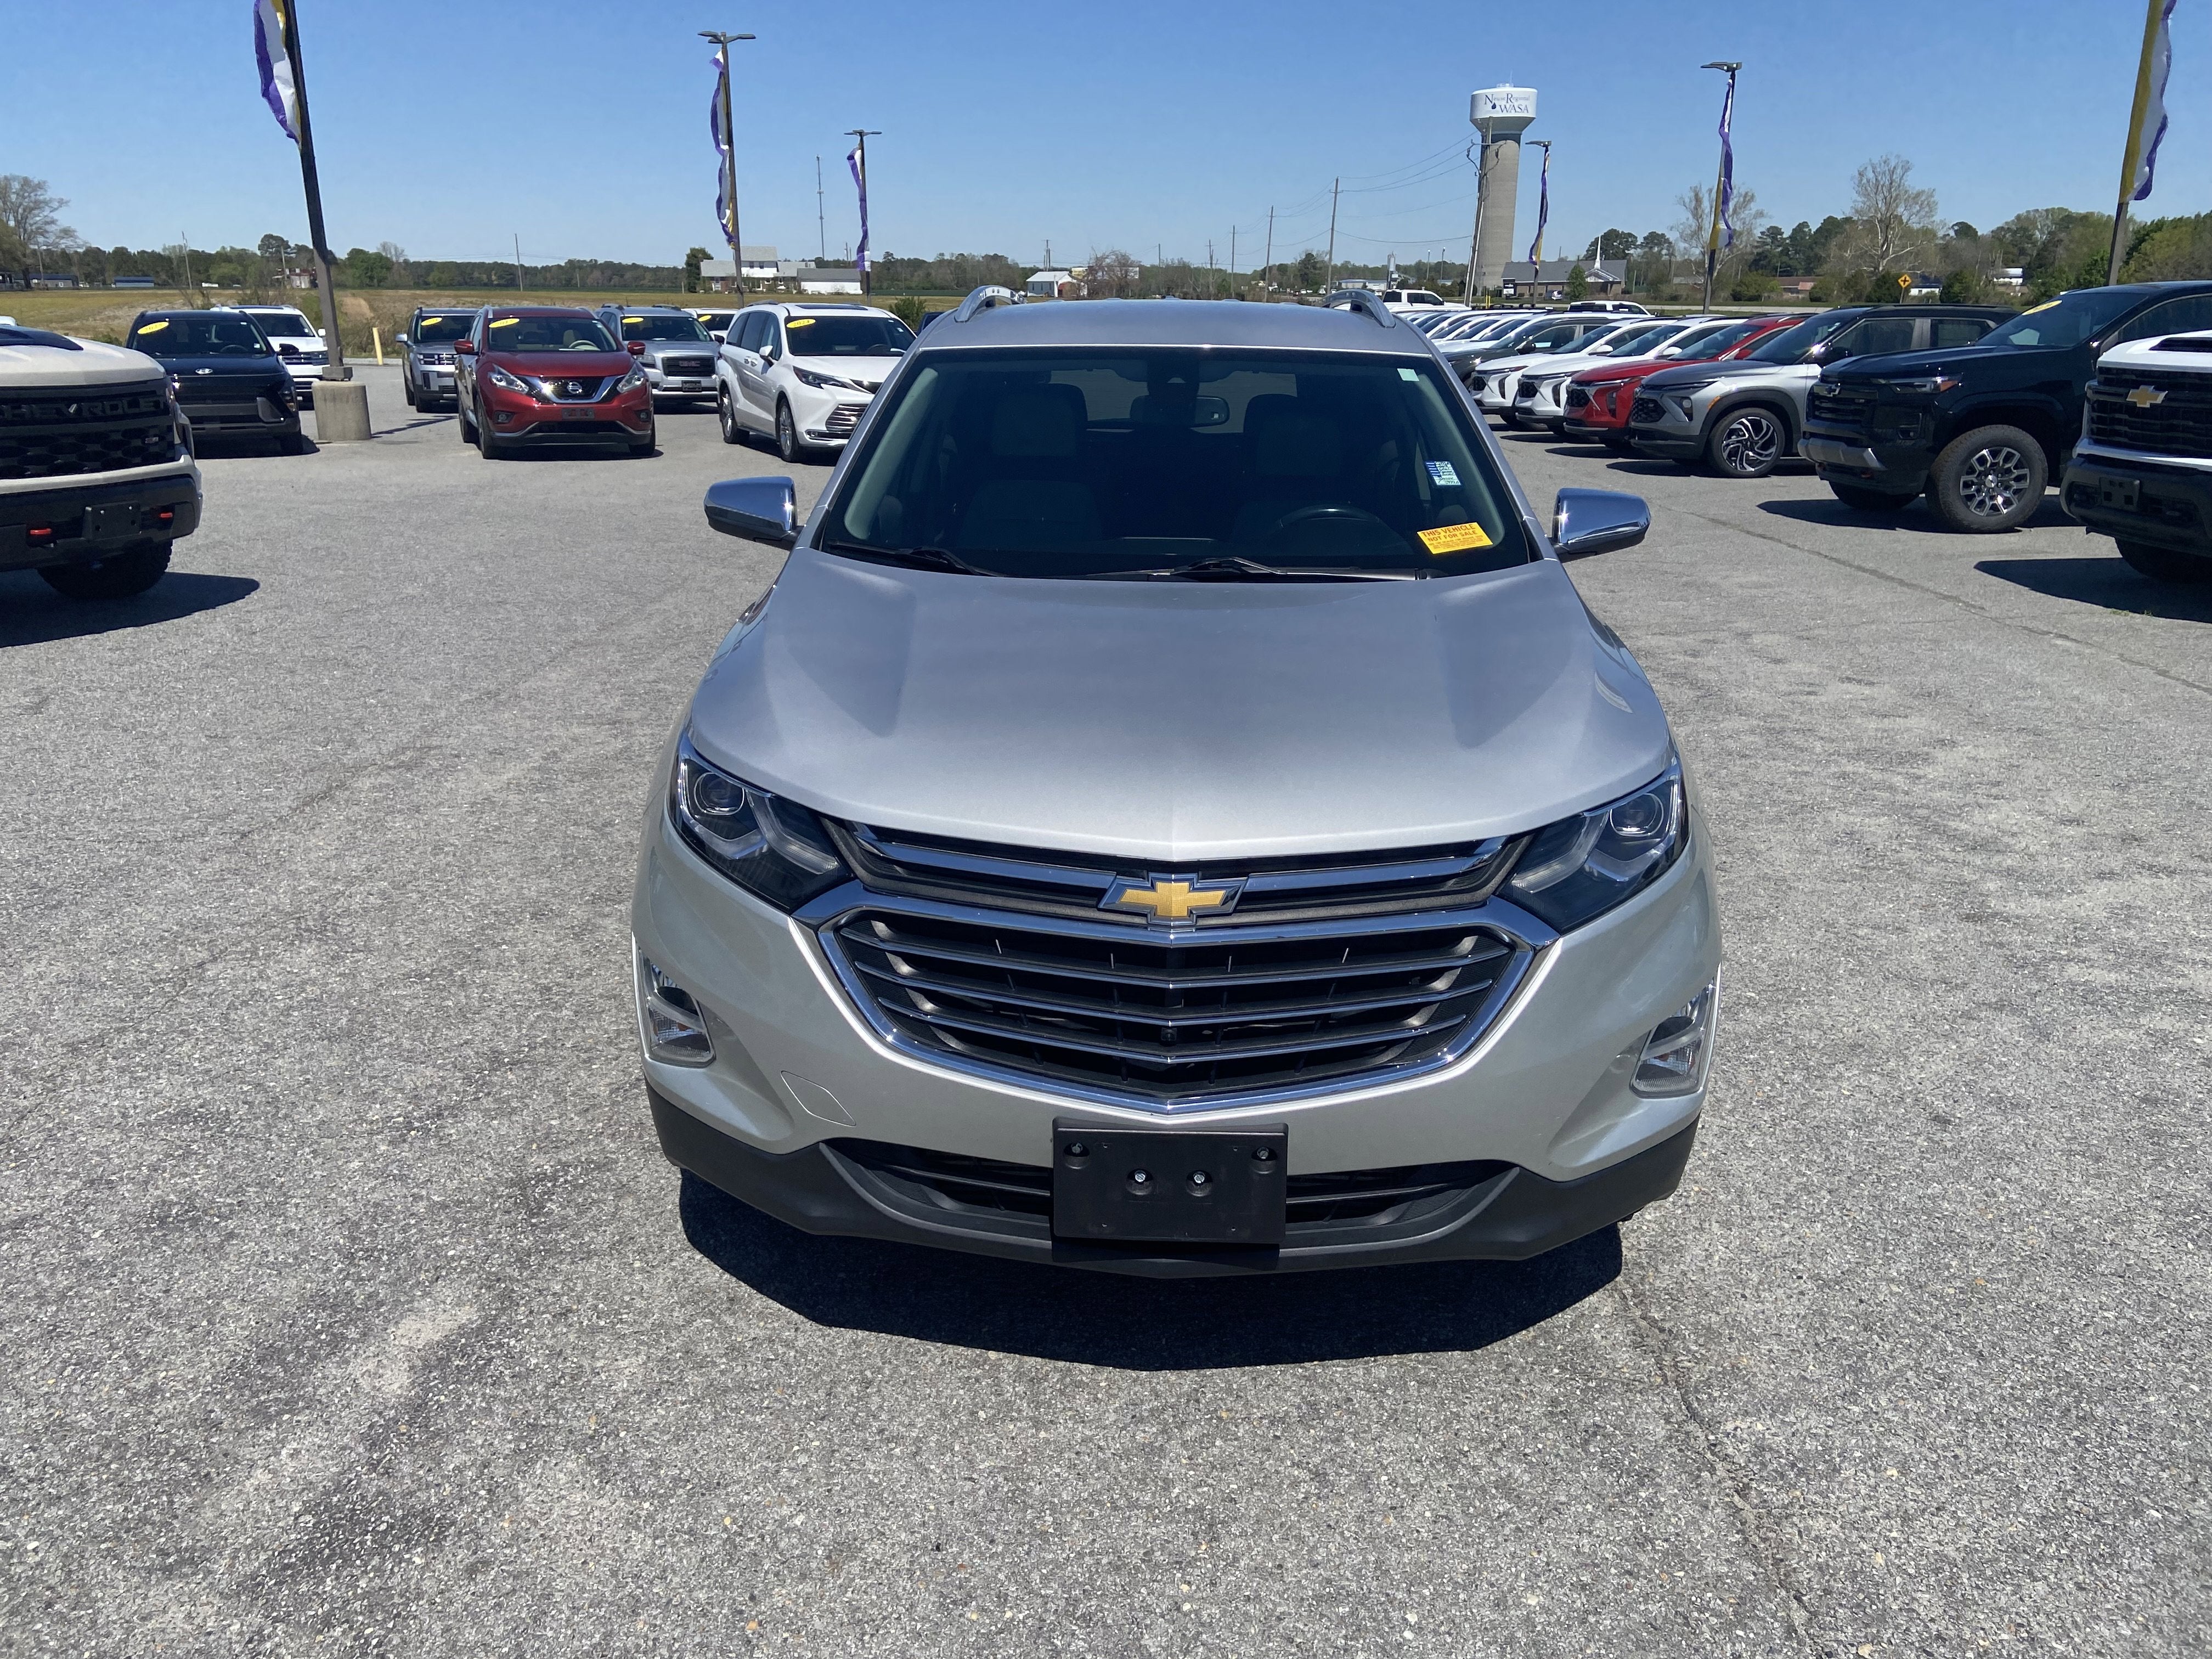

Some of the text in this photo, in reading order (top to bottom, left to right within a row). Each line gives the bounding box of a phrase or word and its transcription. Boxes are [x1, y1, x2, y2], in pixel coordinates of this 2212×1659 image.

[1499, 104, 1529, 114] WASA
[0, 396, 166, 419] HEVROLET
[1442, 524, 1476, 534] VEHICLE
